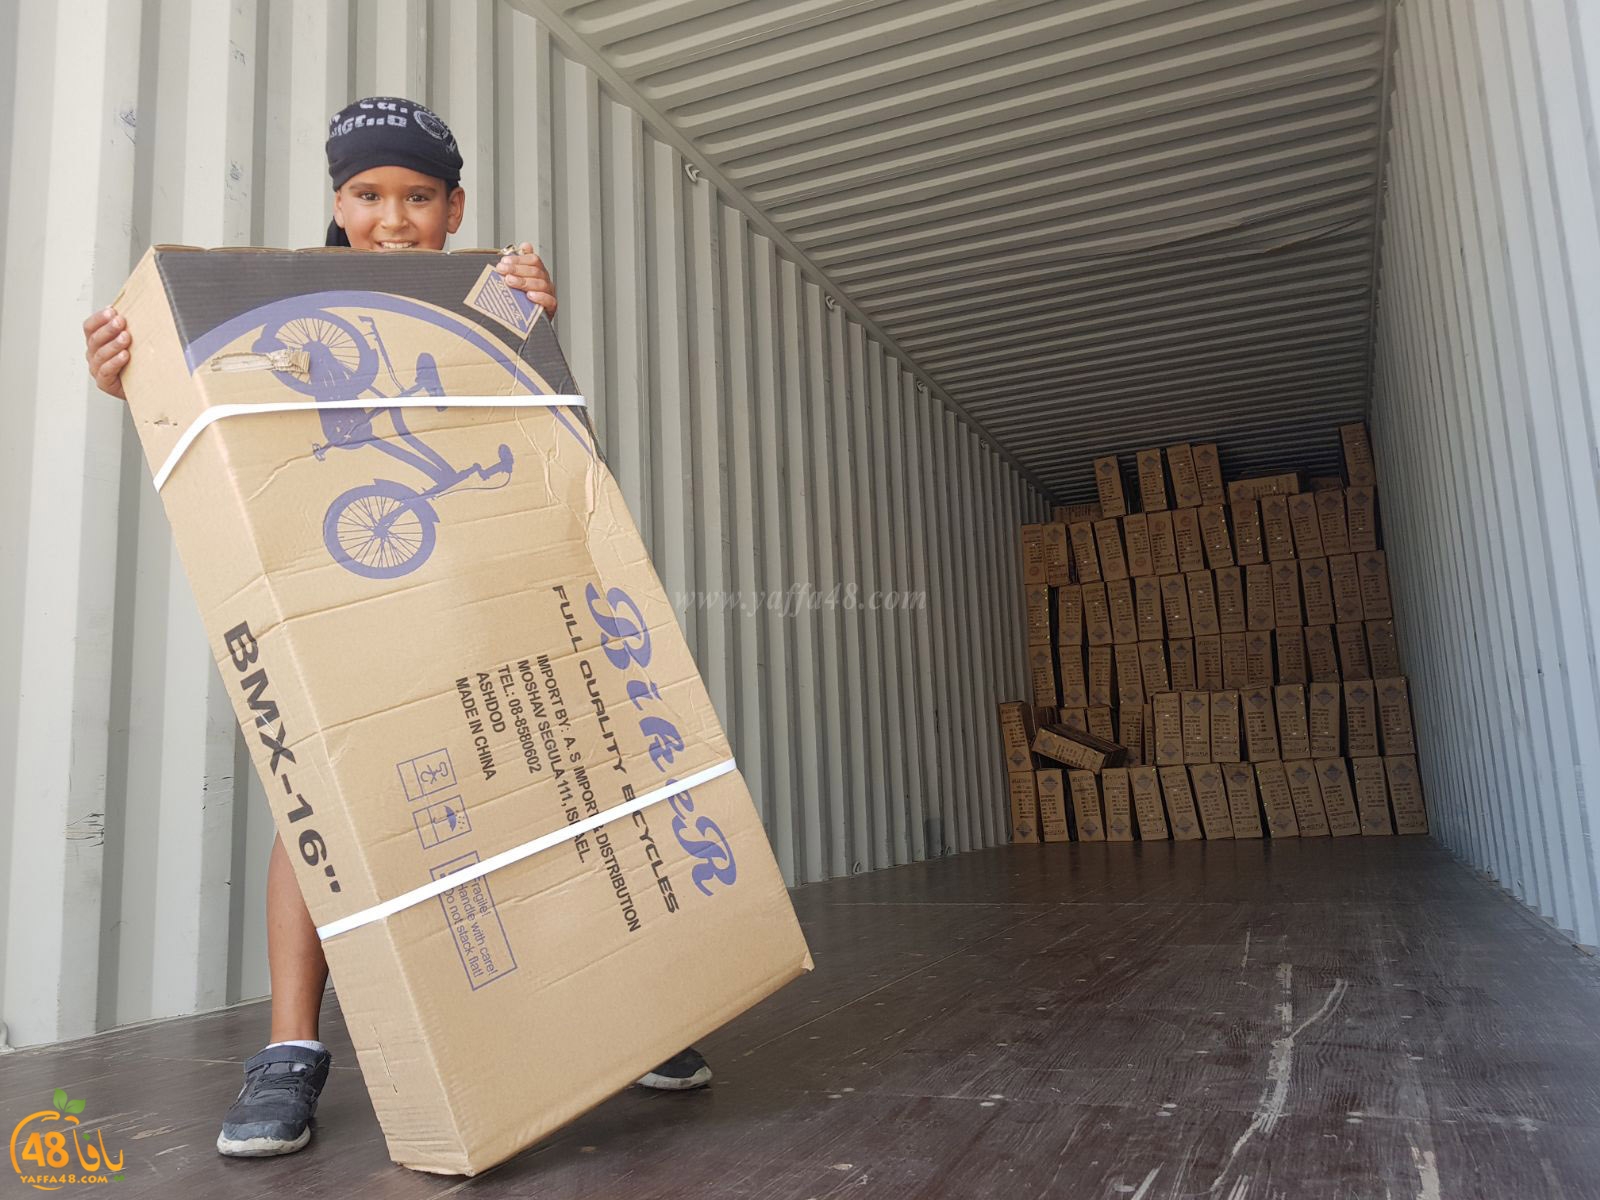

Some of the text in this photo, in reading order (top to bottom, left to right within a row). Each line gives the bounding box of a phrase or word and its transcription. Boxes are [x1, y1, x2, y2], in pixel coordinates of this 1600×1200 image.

[455, 677, 497, 781] MADE IN CHINA
[476, 672, 506, 733] ASHDOD
[498, 664, 542, 774] TEL: 08-8580602
[552, 585, 680, 913] FULL QUALITY BCYCLES
[517, 659, 591, 864] MOSHAV SEGULA 111, ISAEL.
[537, 654, 564, 710] IMPORT
[554, 708, 572, 733] BY:
[569, 751, 582, 763] S
[595, 833, 641, 932] DISTRIBUTION
[443, 887, 485, 978] Do not stack flat!
[458, 884, 498, 976] Handle with care!
